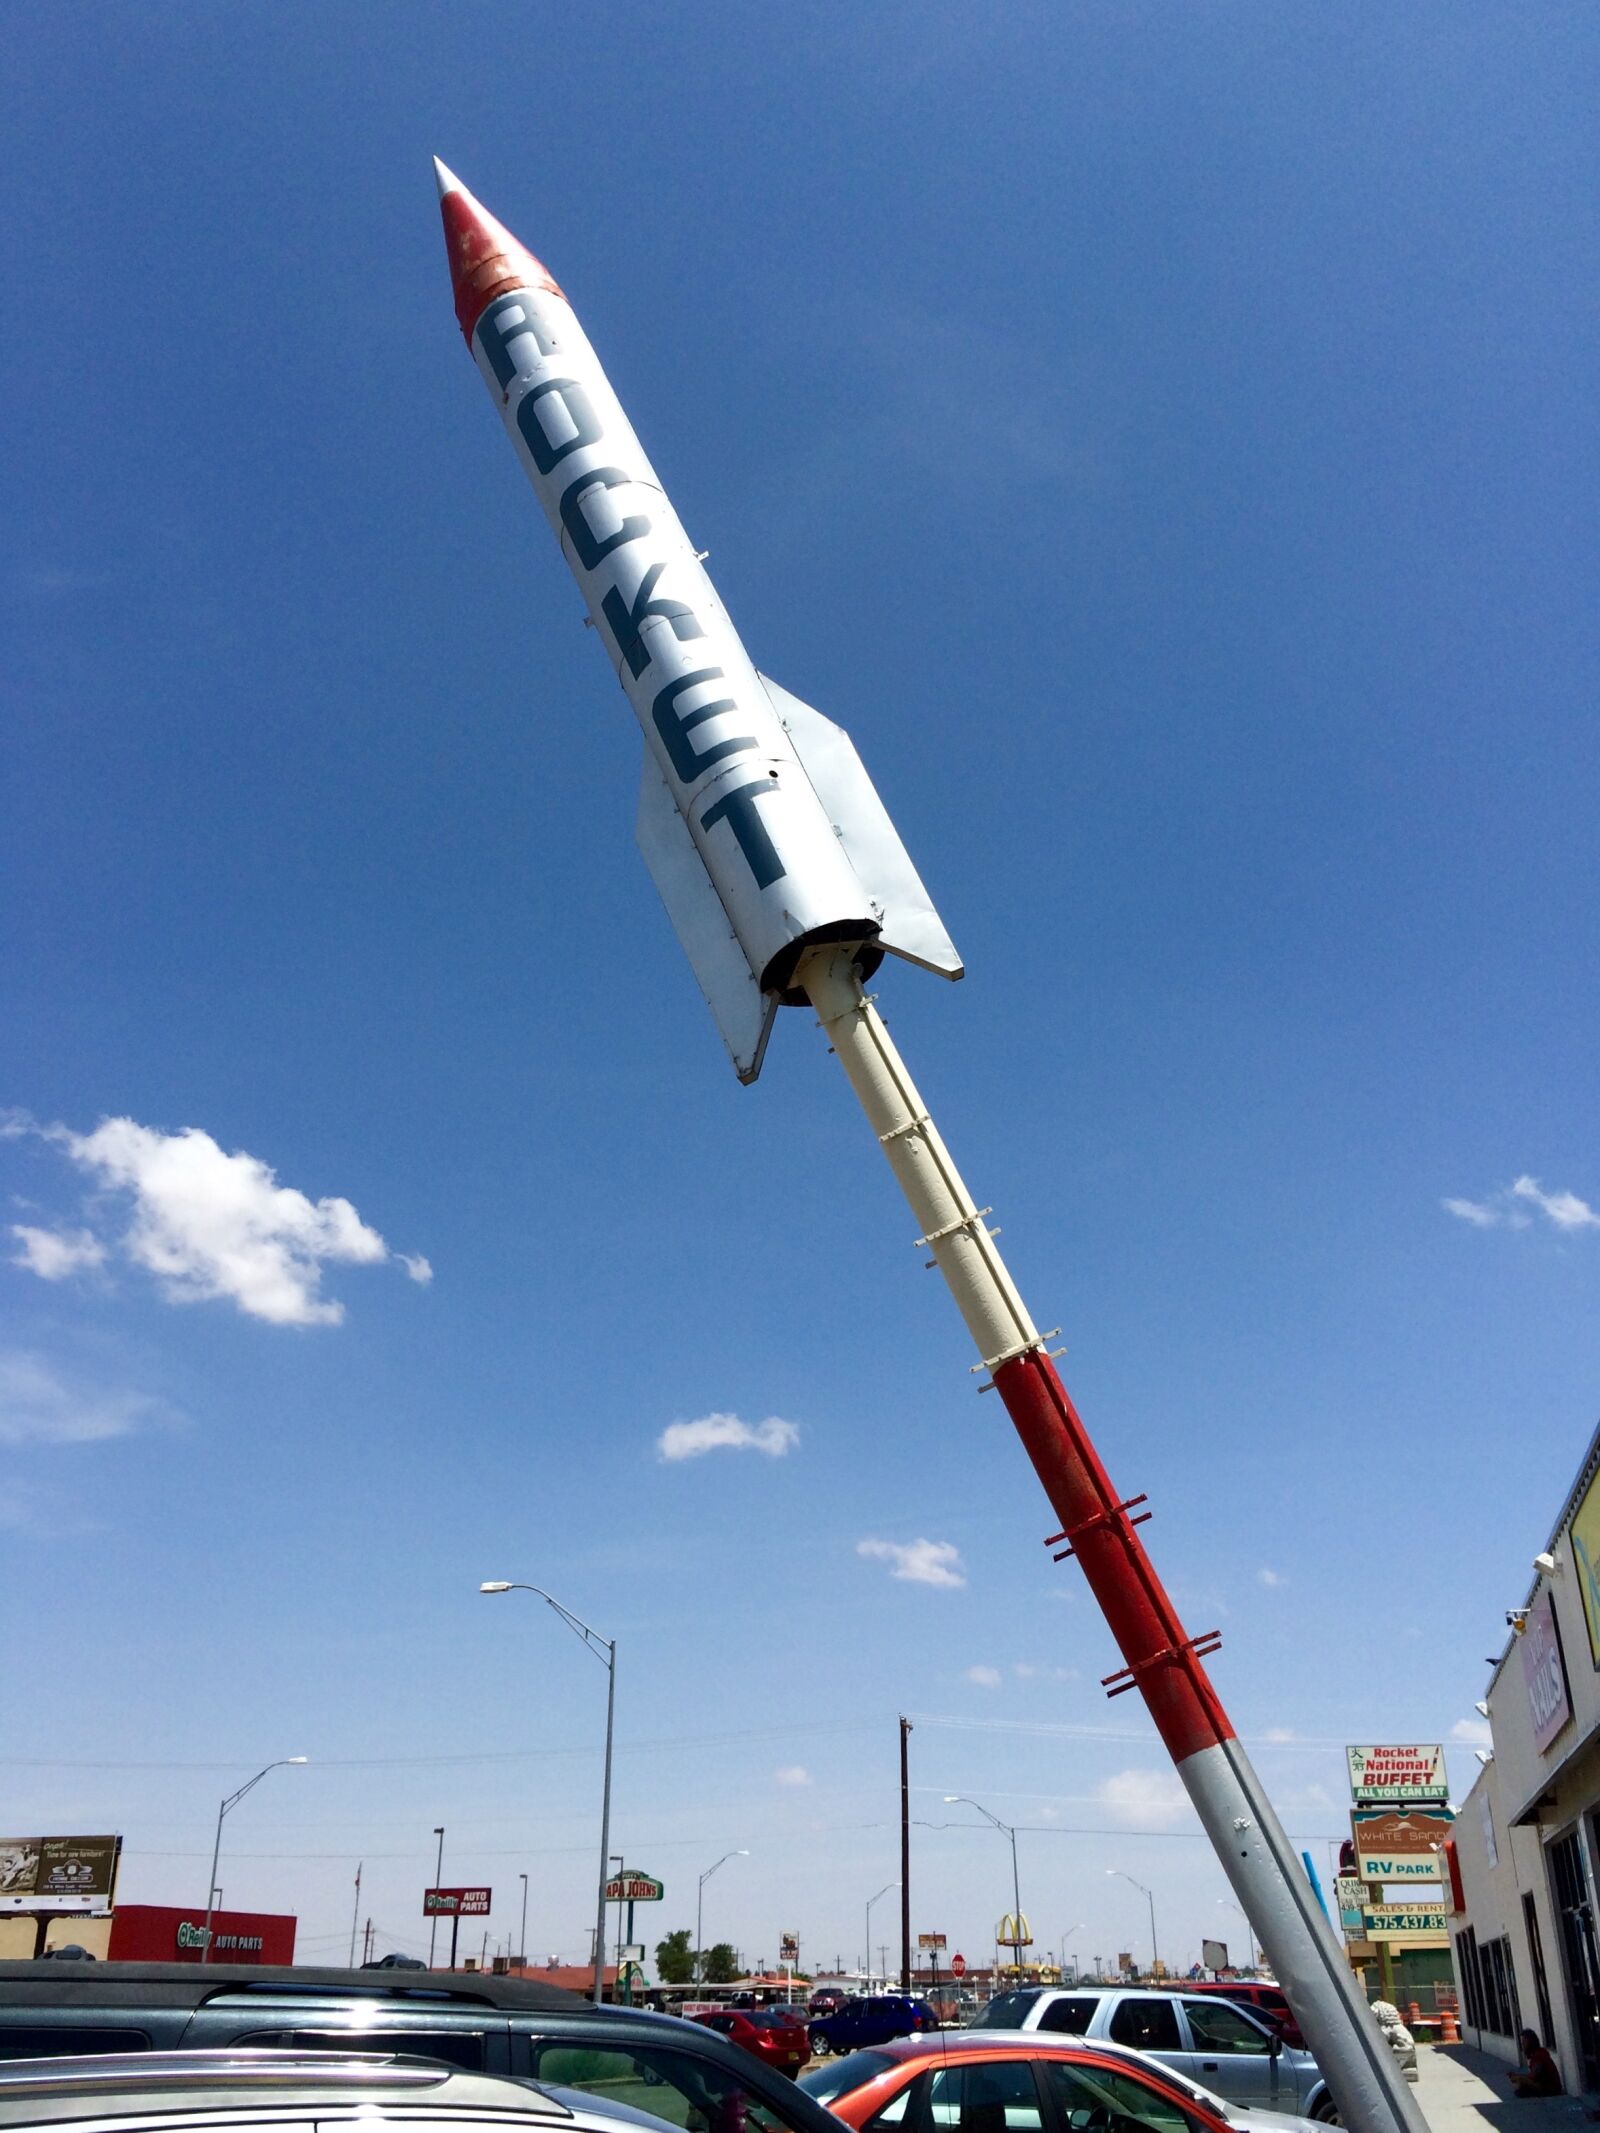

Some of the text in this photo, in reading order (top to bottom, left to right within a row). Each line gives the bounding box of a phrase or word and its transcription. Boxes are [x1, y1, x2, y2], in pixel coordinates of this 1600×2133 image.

[474, 293, 787, 890] ROCKET
[1373, 1747, 1418, 1758] Rocket
[1366, 1759, 1429, 1771] National
[1363, 1772, 1434, 1786] BUFFET
[1357, 1787, 1445, 1798] ALL YOU CAN EAT
[1359, 1831, 1447, 1841] WHITE SAND
[1366, 1861, 1434, 1874] RV PARK
[606, 1881, 625, 1897] APA
[1343, 1887, 1367, 1896] CASH
[463, 1891, 487, 1901] AUTO
[460, 1901, 488, 1912] PARTS
[1372, 1905, 1404, 1913] SALES
[1373, 1915, 1447, 1929] 575.437.83
[215, 1935, 236, 1949] AUTO
[238, 1936, 263, 1950] PARTS
[952, 1961, 965, 1971] STOP
